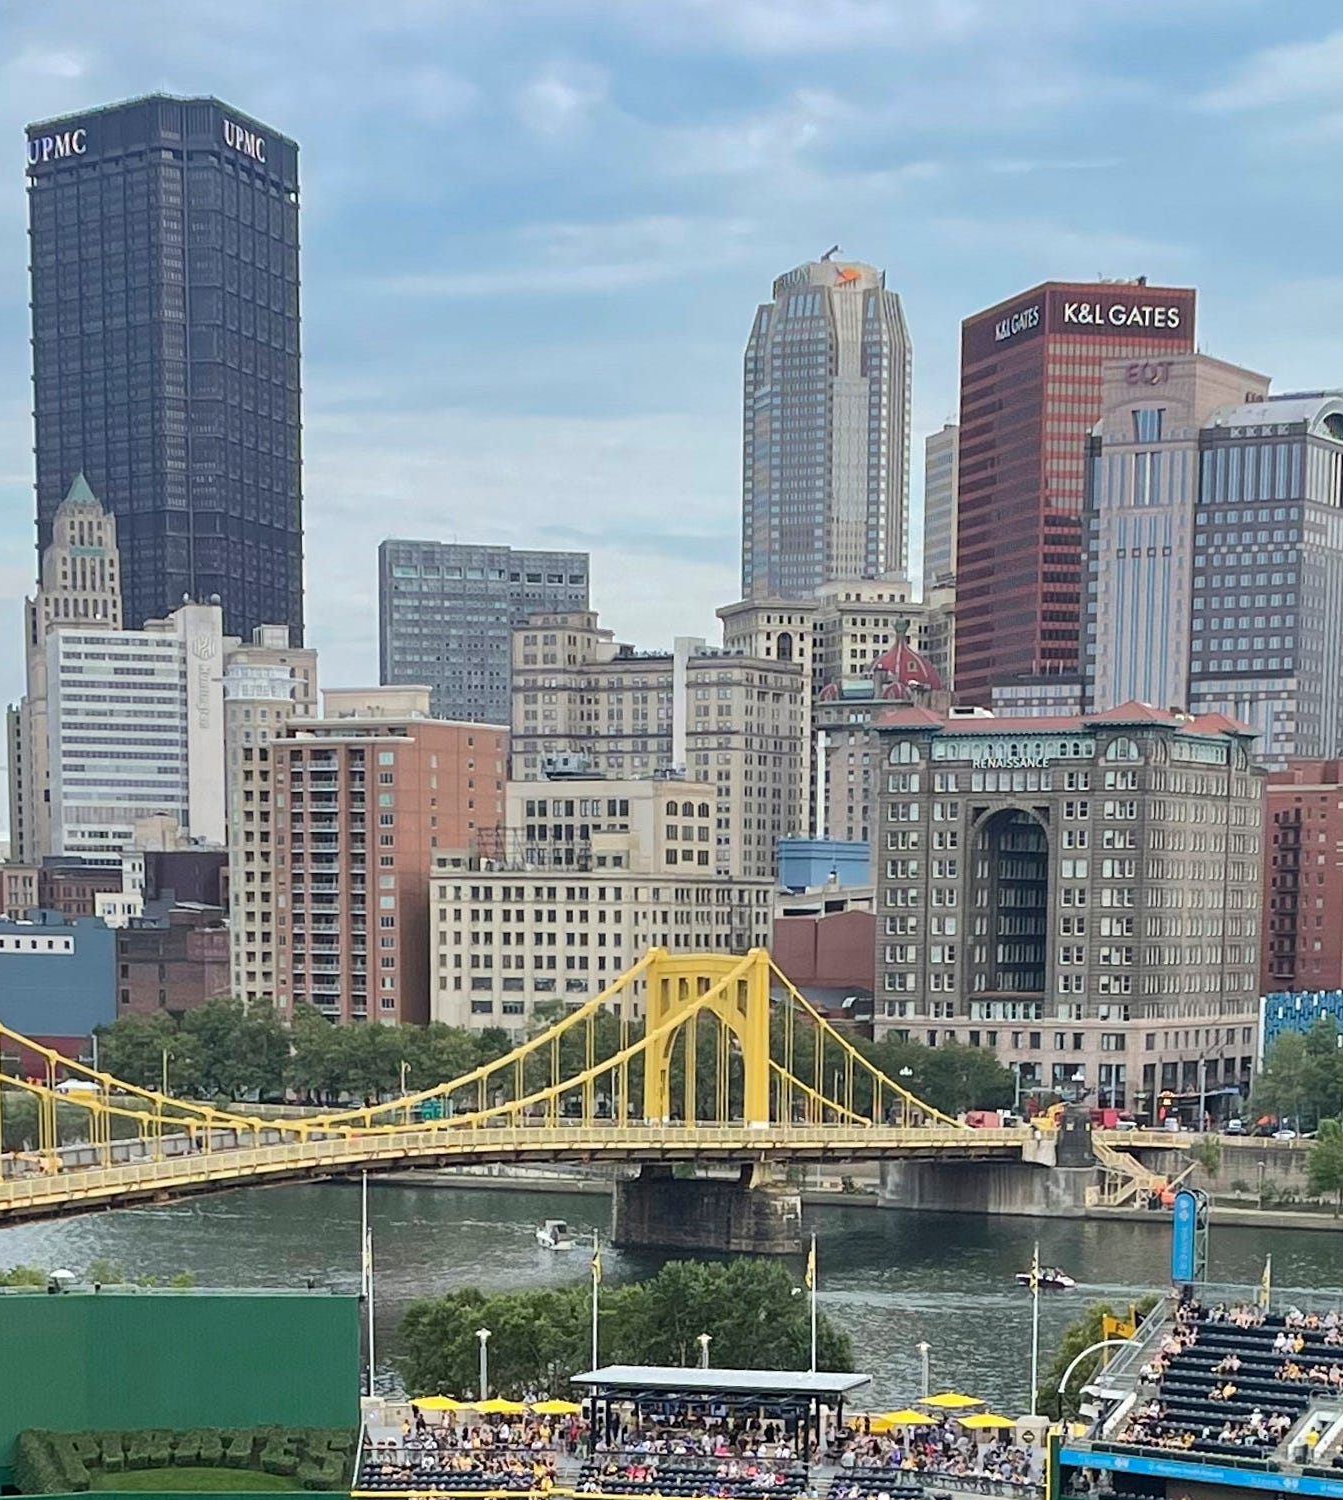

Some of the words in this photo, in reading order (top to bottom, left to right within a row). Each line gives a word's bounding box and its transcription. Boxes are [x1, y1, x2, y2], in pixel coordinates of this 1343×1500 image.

[26, 128, 87, 165] UPMC
[223, 119, 266, 164] UPMC
[1011, 305, 1040, 335] GATES
[1064, 302, 1105, 325] K&L
[1108, 304, 1180, 329] GATES
[972, 756, 1049, 769] RENAISSANCE
